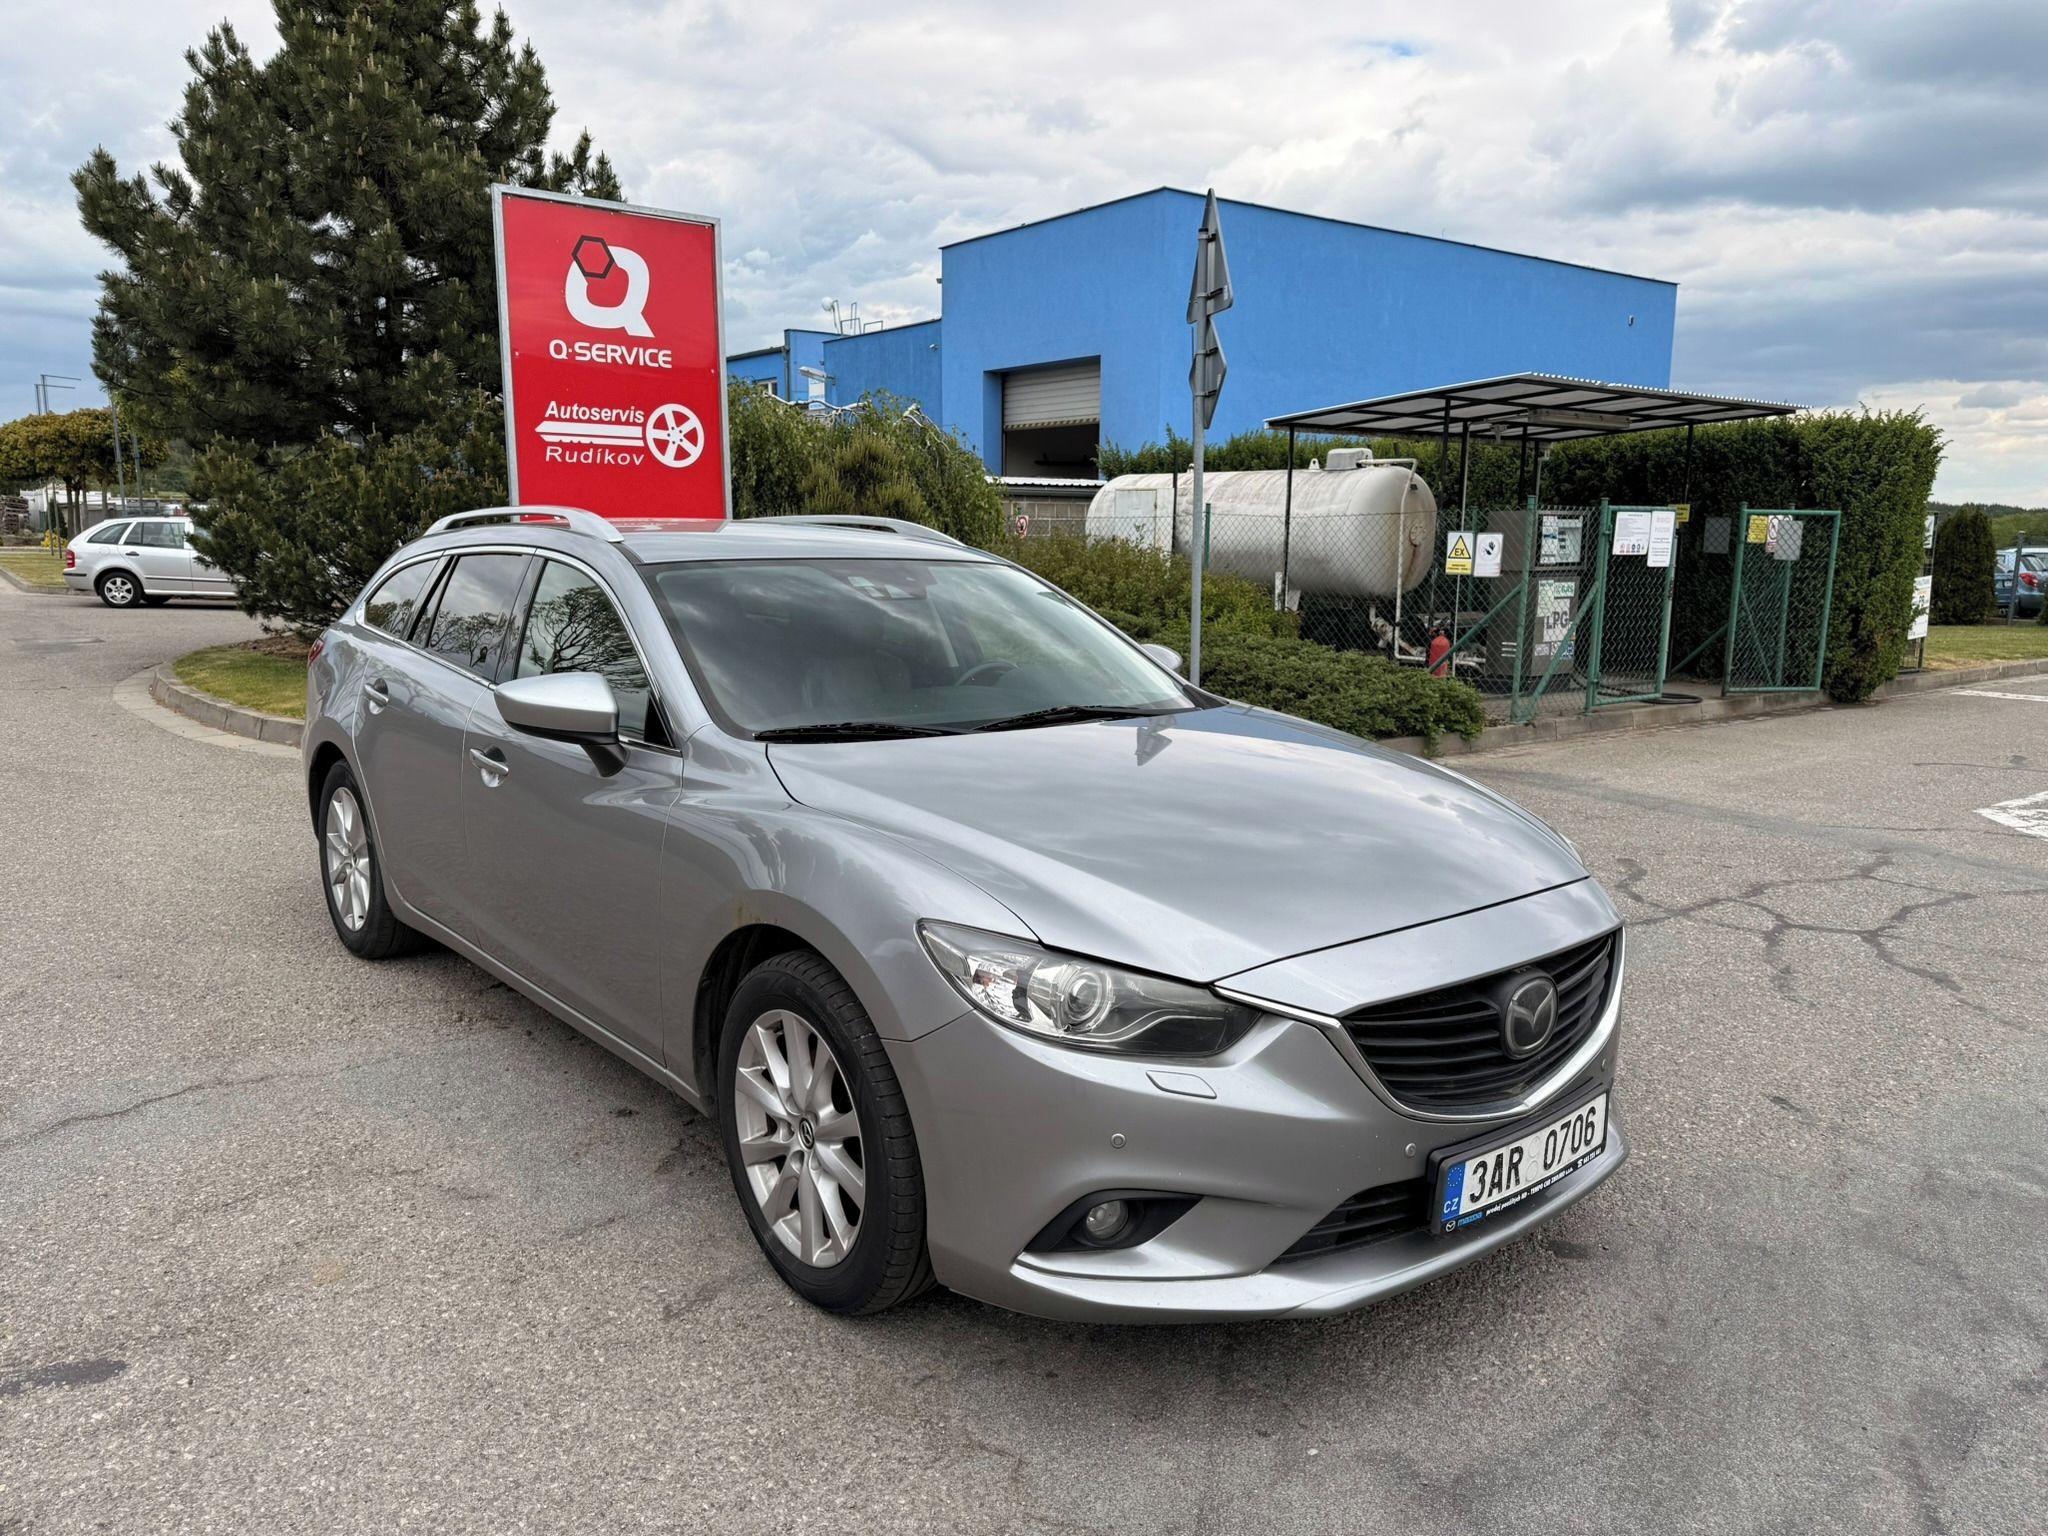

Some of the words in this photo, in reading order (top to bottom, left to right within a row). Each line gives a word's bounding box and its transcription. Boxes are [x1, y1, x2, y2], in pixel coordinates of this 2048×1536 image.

[545, 401, 645, 423] Autoservis
[545, 446, 645, 466] Rudíkov
[1454, 548, 1465, 556] EX
[1546, 611, 1569, 629] LPG
[1469, 1146, 1524, 1203] 3AR
[1543, 1106, 1597, 1170] 0706
[1443, 1198, 1459, 1214] CZ
